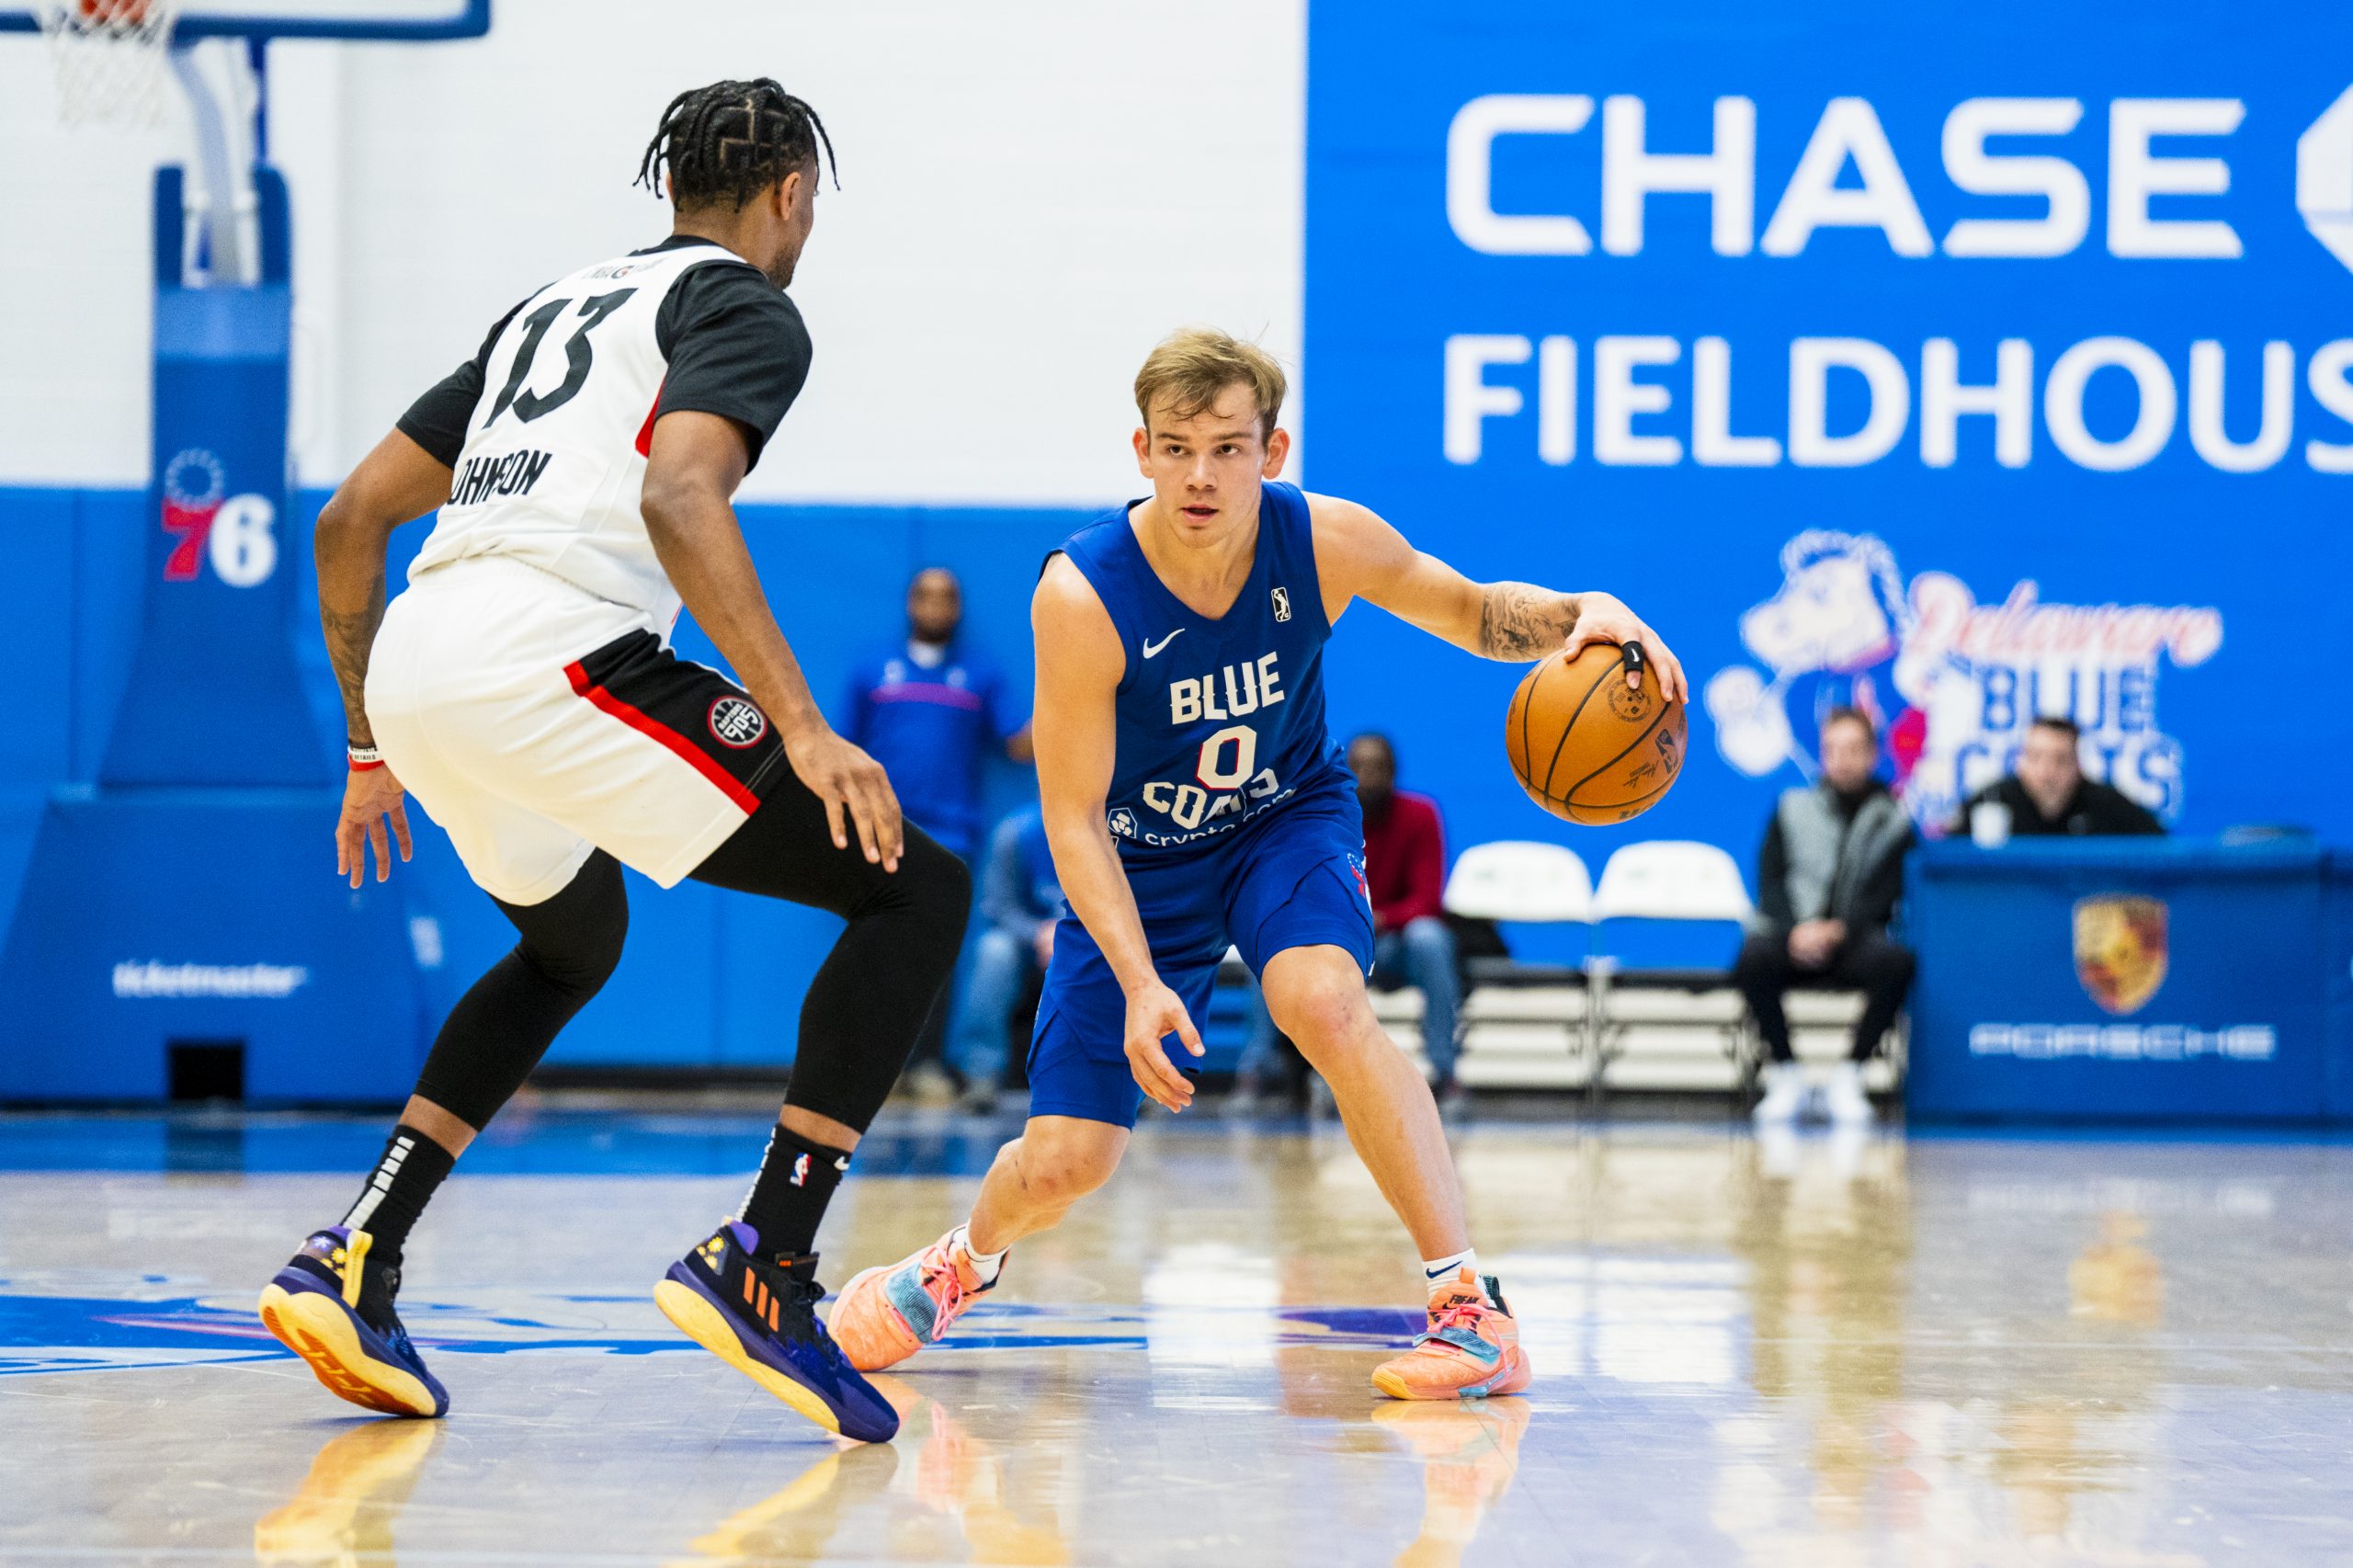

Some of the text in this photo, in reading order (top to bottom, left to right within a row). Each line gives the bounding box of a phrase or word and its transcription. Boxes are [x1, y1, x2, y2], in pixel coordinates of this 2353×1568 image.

[1446, 93, 2246, 258] CHASE
[482, 288, 639, 430] 13
[161, 494, 277, 589] 76
[723, 706, 759, 740] 905
[1170, 651, 1285, 725] BLUE
[1980, 662, 2153, 732] BLUE
[1195, 724, 1256, 791] 0
[1954, 736, 2178, 814] CTS
[1142, 767, 1279, 831] COS
